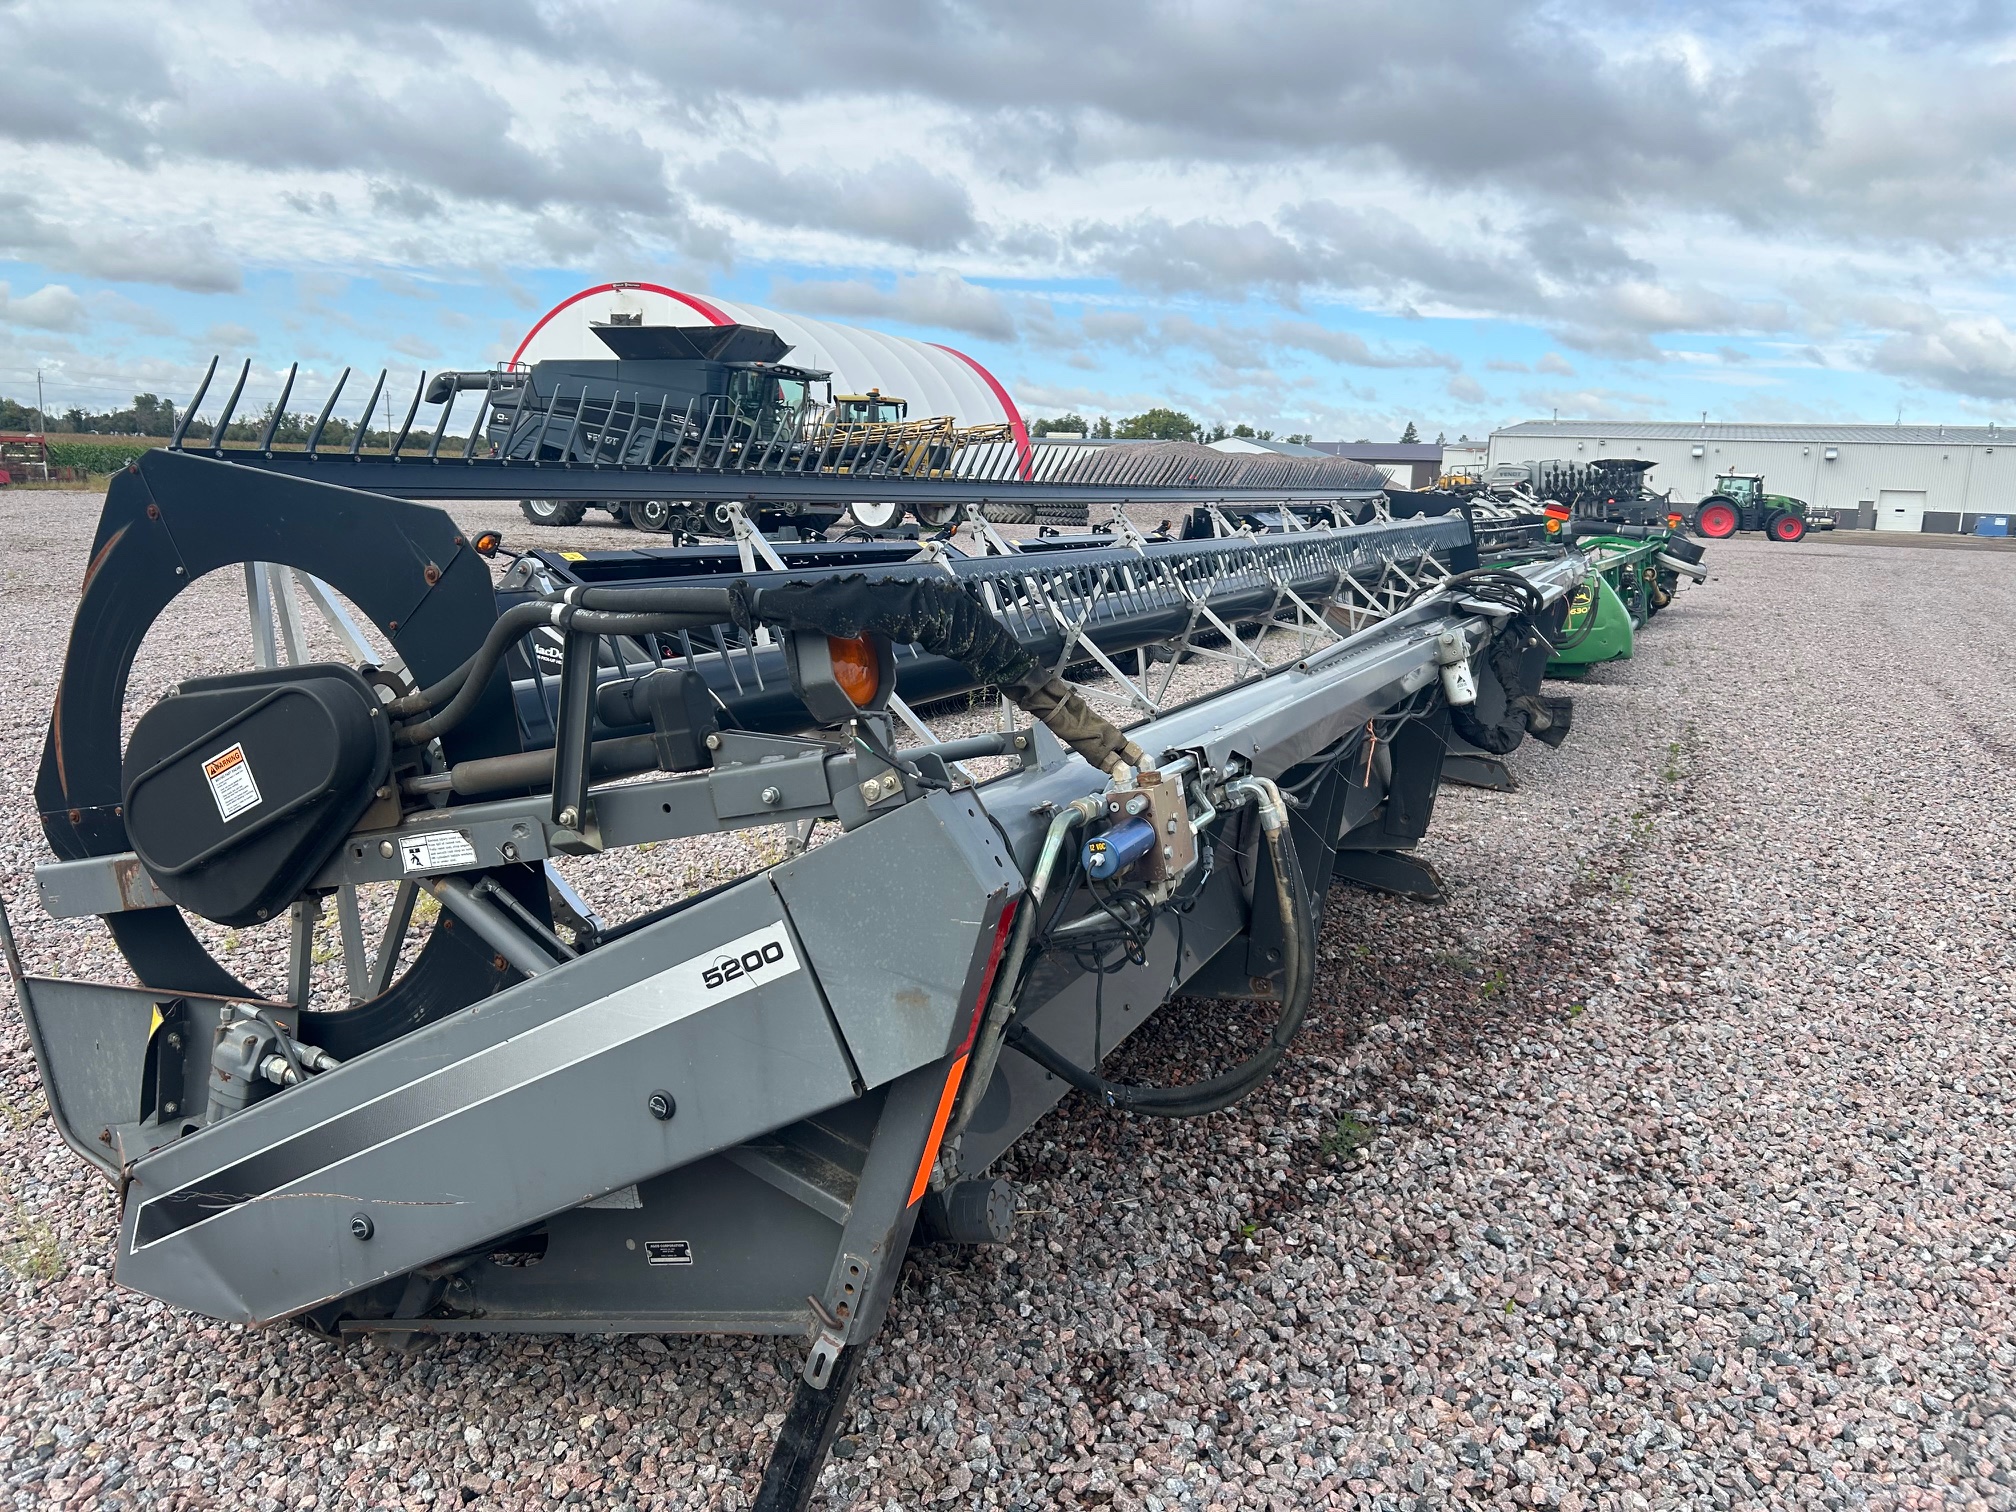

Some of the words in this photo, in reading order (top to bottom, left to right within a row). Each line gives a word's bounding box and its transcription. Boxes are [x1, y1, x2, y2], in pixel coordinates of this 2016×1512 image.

[670, 413, 696, 426] IDEL
[586, 431, 620, 446] FEDT
[214, 752, 240, 771] WARNING
[702, 941, 784, 989] 5200
